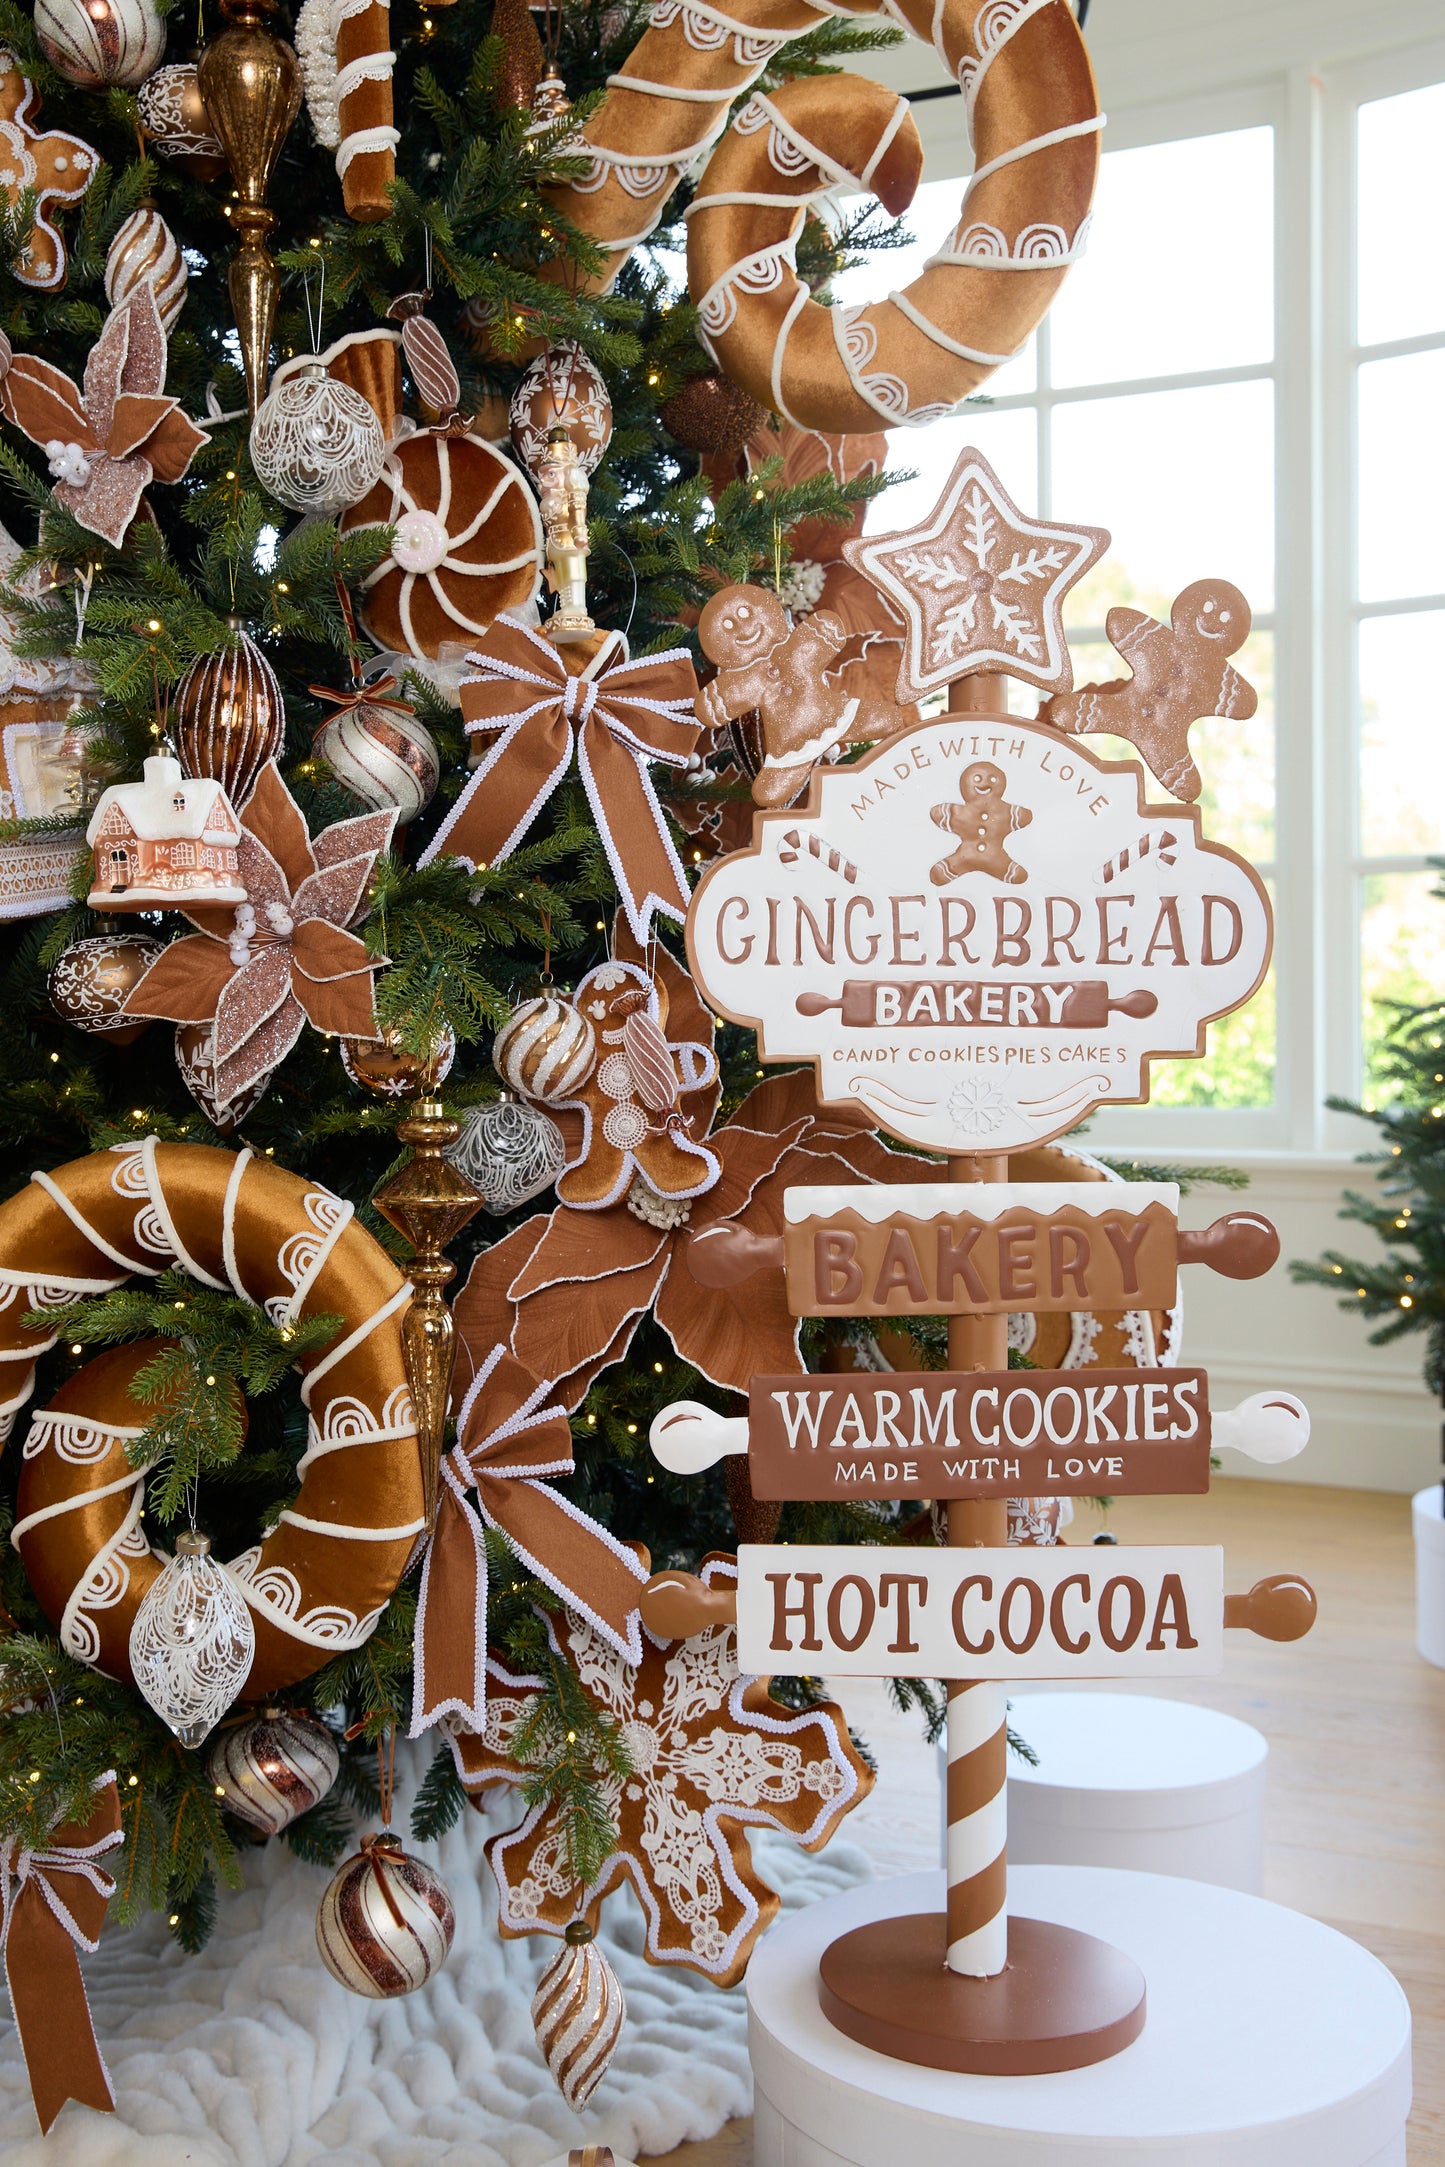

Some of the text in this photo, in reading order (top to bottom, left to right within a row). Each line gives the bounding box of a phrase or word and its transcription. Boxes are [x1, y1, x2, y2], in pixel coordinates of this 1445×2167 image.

[851, 736, 1110, 821] MADE WITH LOVE
[715, 894, 1244, 968] GINGERBREAD
[874, 984, 1075, 1026] BAKERY
[832, 1045, 1127, 1065] CANDY COOKIES PIES CAKES
[814, 1223, 1149, 1304] BAKERY
[771, 1379, 1200, 1449] WARM COOKIES
[836, 1456, 1124, 1483] MADE WITH LOVE
[764, 1573, 1199, 1656] HOT COCOA
